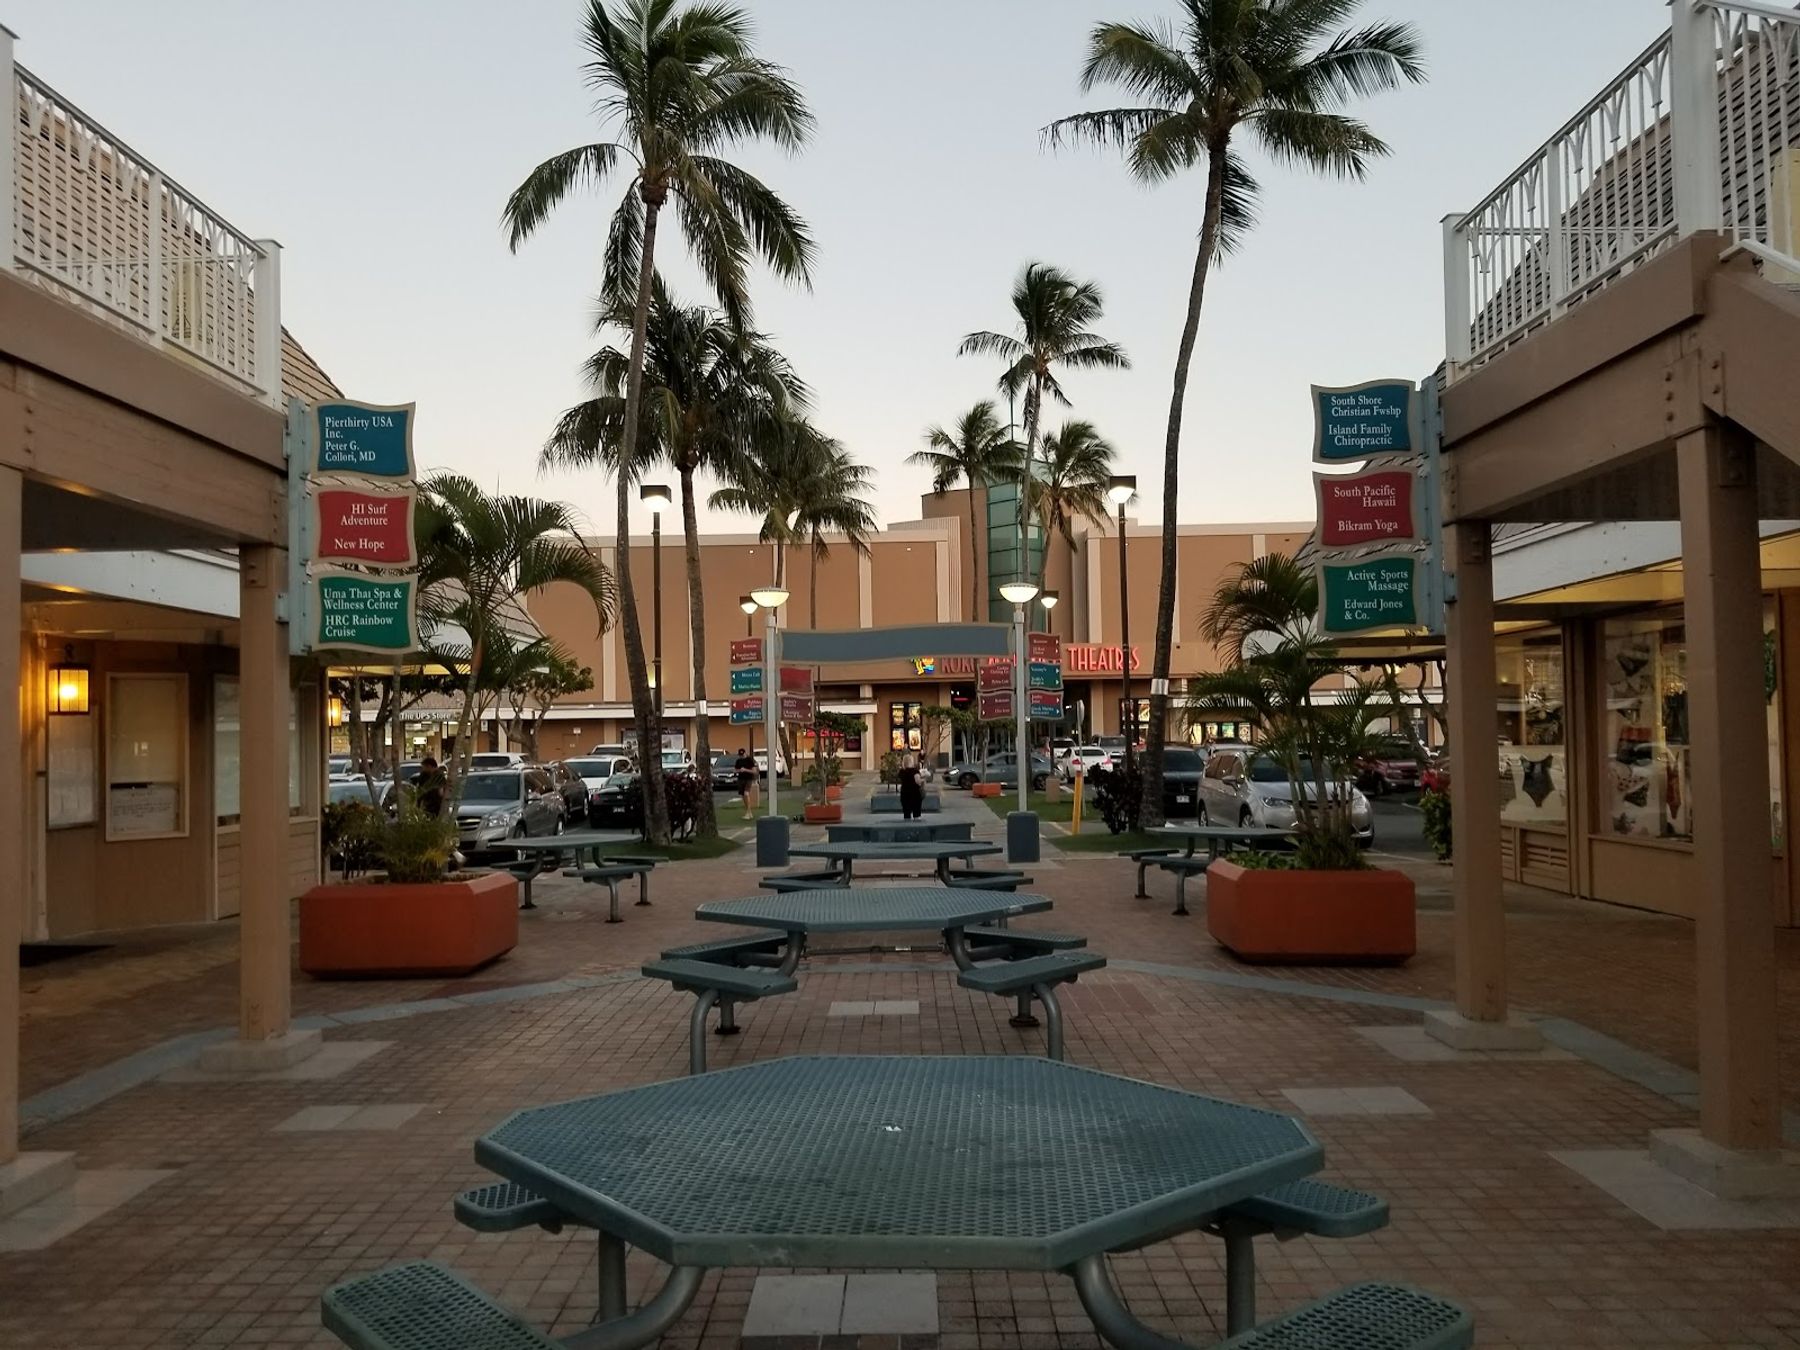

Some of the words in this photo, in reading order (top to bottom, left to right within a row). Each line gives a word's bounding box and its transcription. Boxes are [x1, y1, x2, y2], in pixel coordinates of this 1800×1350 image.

[1331, 396, 1356, 405] South
[1358, 396, 1382, 405] Shore
[1331, 406, 1371, 417] Christian
[1373, 406, 1401, 418] Fwshp
[372, 416, 393, 428] USA
[325, 428, 343, 439] Inc.
[1328, 424, 1357, 435] Island
[1360, 424, 1392, 436] Family
[325, 441, 348, 451] Peter
[349, 441, 360, 451] G.
[1334, 435, 1392, 448] Chiropractic
[359, 451, 376, 461] MD
[1334, 486, 1361, 497] South
[1363, 485, 1396, 496] Pacific
[1363, 496, 1396, 507] Hawaii
[351, 504, 365, 514] HI
[367, 503, 388, 514] Surf
[340, 515, 388, 526] Adventure
[1338, 520, 1372, 531] Bikram
[1375, 520, 1398, 532] Yoga
[334, 538, 355, 550] New
[359, 538, 385, 552] Hope
[1347, 570, 1376, 581] Active
[1381, 570, 1408, 581] Sports
[1367, 581, 1408, 593] Massage
[323, 588, 346, 599] Uma
[350, 588, 371, 599] Thai
[374, 588, 391, 601] Spa
[393, 588, 402, 599] &
[324, 599, 364, 610] Wellness
[366, 599, 398, 610] Center
[1344, 599, 1377, 609] Edward
[1379, 599, 1403, 612] Jones
[326, 614, 349, 626] HRC
[352, 614, 393, 626] Rainbow
[1344, 610, 1353, 620] &
[1354, 610, 1370, 620] Co.
[325, 626, 356, 637] Cruise
[1067, 647, 1140, 670] THEATRS
[416, 712, 430, 720] UPS
